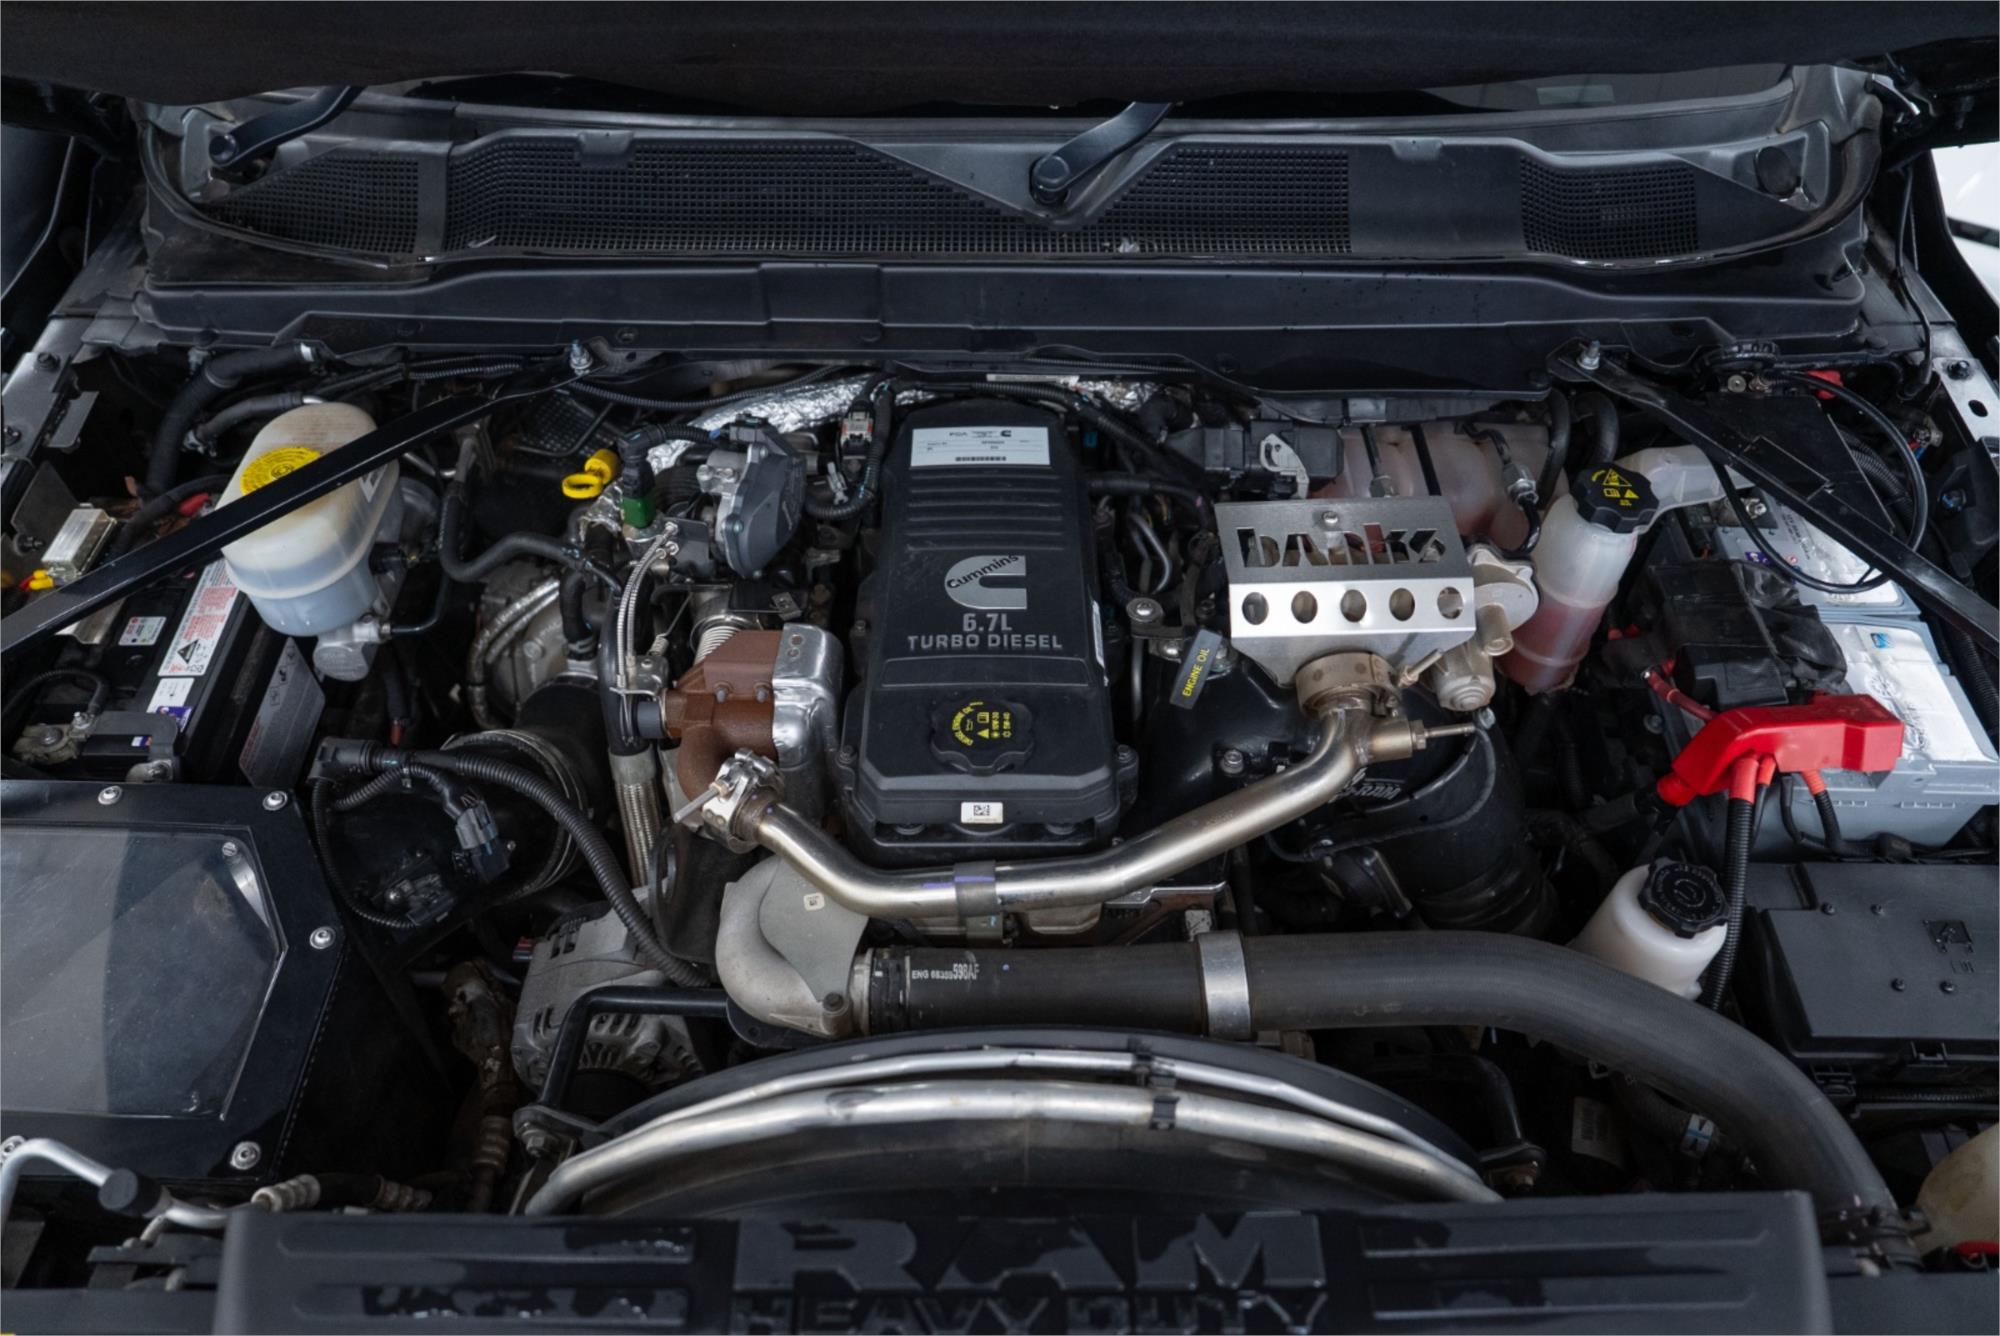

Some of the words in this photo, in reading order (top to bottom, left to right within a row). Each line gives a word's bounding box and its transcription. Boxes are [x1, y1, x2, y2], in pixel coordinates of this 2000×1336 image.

[946, 553, 1020, 589] Cummins
[962, 612, 1013, 632] 6.7L
[907, 633, 981, 651] TURBO
[987, 634, 1063, 649] DIESEL
[1182, 664, 1204, 697] ENGINE
[1196, 648, 1211, 663] OIL
[911, 969, 930, 980] ENG
[732, 1212, 1328, 1292] RAM
[729, 1295, 1050, 1335] HEAVY
[1066, 1293, 1328, 1335] DUTY
